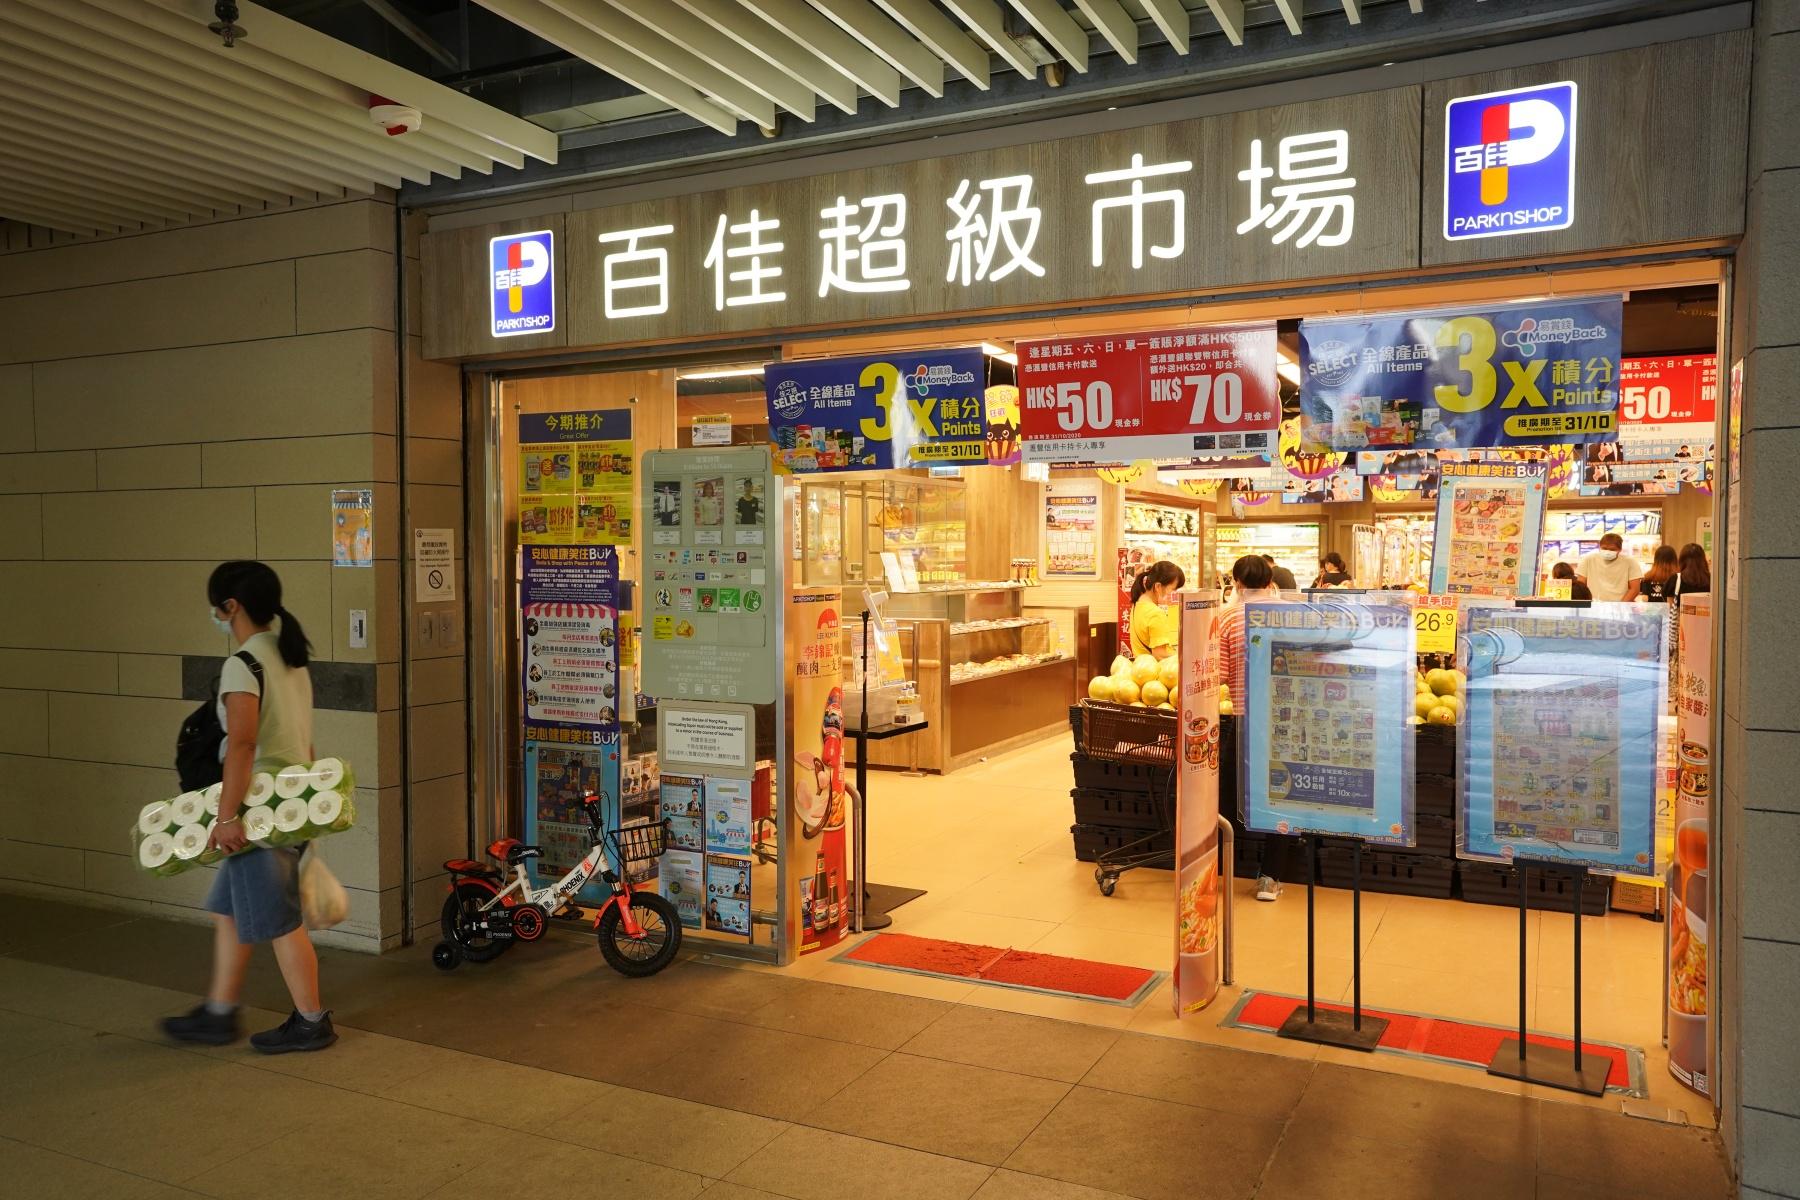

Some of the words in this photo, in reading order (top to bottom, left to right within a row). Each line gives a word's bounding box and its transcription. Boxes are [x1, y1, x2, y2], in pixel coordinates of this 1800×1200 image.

[598, 129, 1358, 323] 百佳超級市場
[1529, 327, 1606, 343] MoneyBack
[1362, 343, 1429, 363] 全線產品
[1308, 354, 1358, 376] SELECT
[1367, 363, 1383, 374] All
[1387, 361, 1423, 373] Items
[1552, 357, 1613, 385] 積分
[923, 371, 973, 385] MoneyBack
[773, 390, 807, 410] SELECT
[810, 384, 856, 399] 全線產品
[1151, 372, 1243, 425] HK$70
[1553, 387, 1612, 406] Points
[813, 399, 824, 409] All
[827, 398, 852, 408] Items
[940, 397, 980, 419] 積分
[1026, 380, 1113, 431] HK$50
[545, 414, 603, 431] 今期推介
[942, 422, 981, 436] Points
[1518, 417, 1562, 428] 推廣期至
[1565, 415, 1610, 430] 31/10
[951, 445, 981, 456] 31/10
